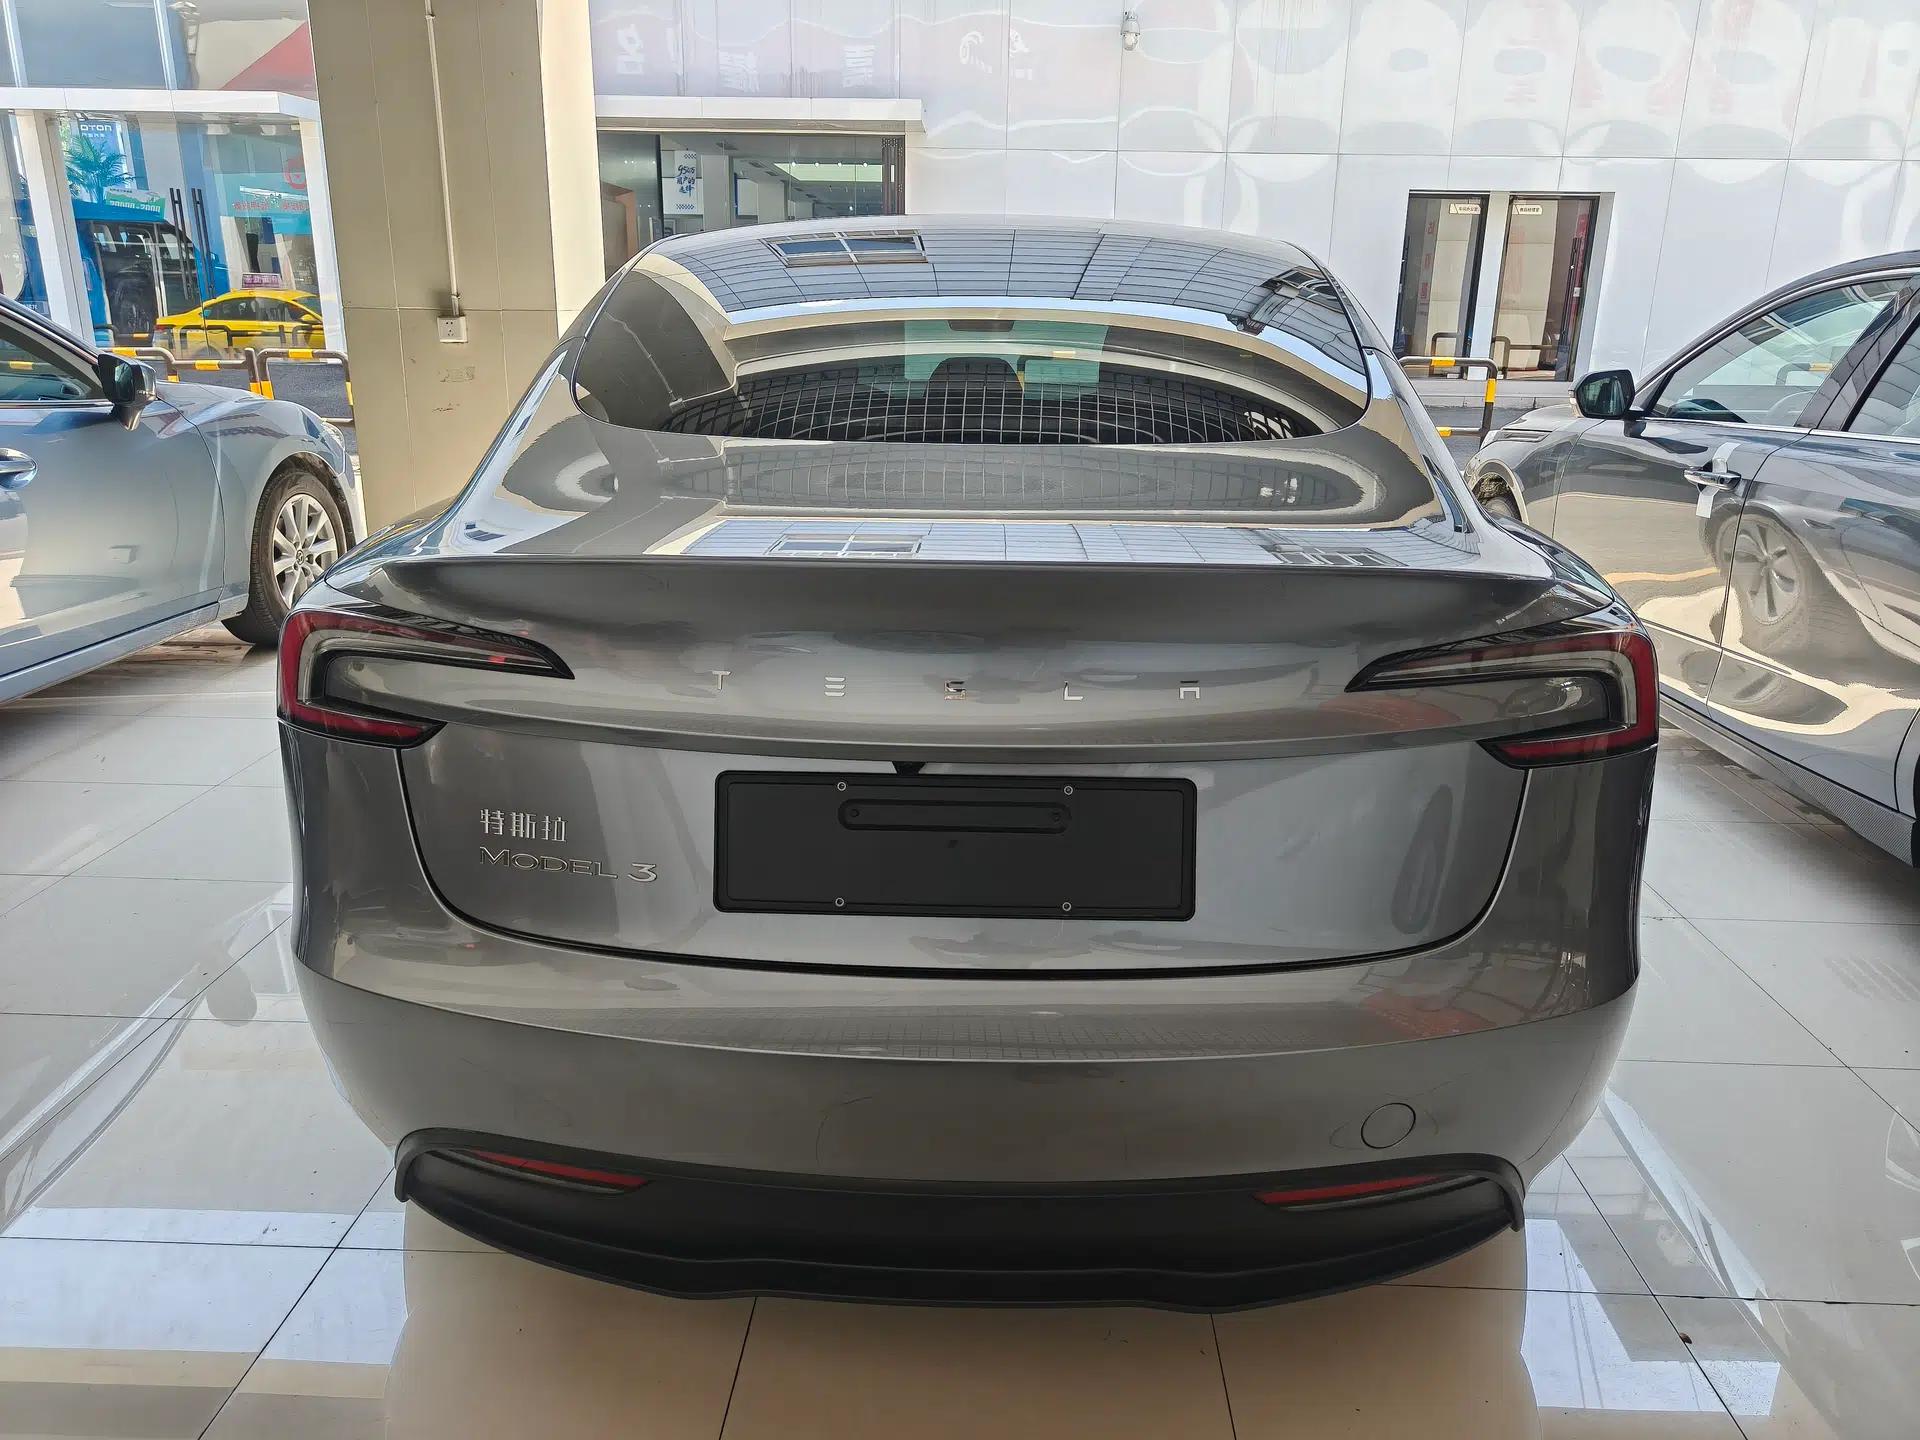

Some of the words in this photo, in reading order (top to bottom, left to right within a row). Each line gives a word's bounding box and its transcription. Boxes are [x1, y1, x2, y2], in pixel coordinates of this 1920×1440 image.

[712, 670, 1201, 701] TESLA
[480, 808, 568, 842] 特斯拉
[480, 846, 618, 879] MODEL
[627, 863, 657, 882] 3
